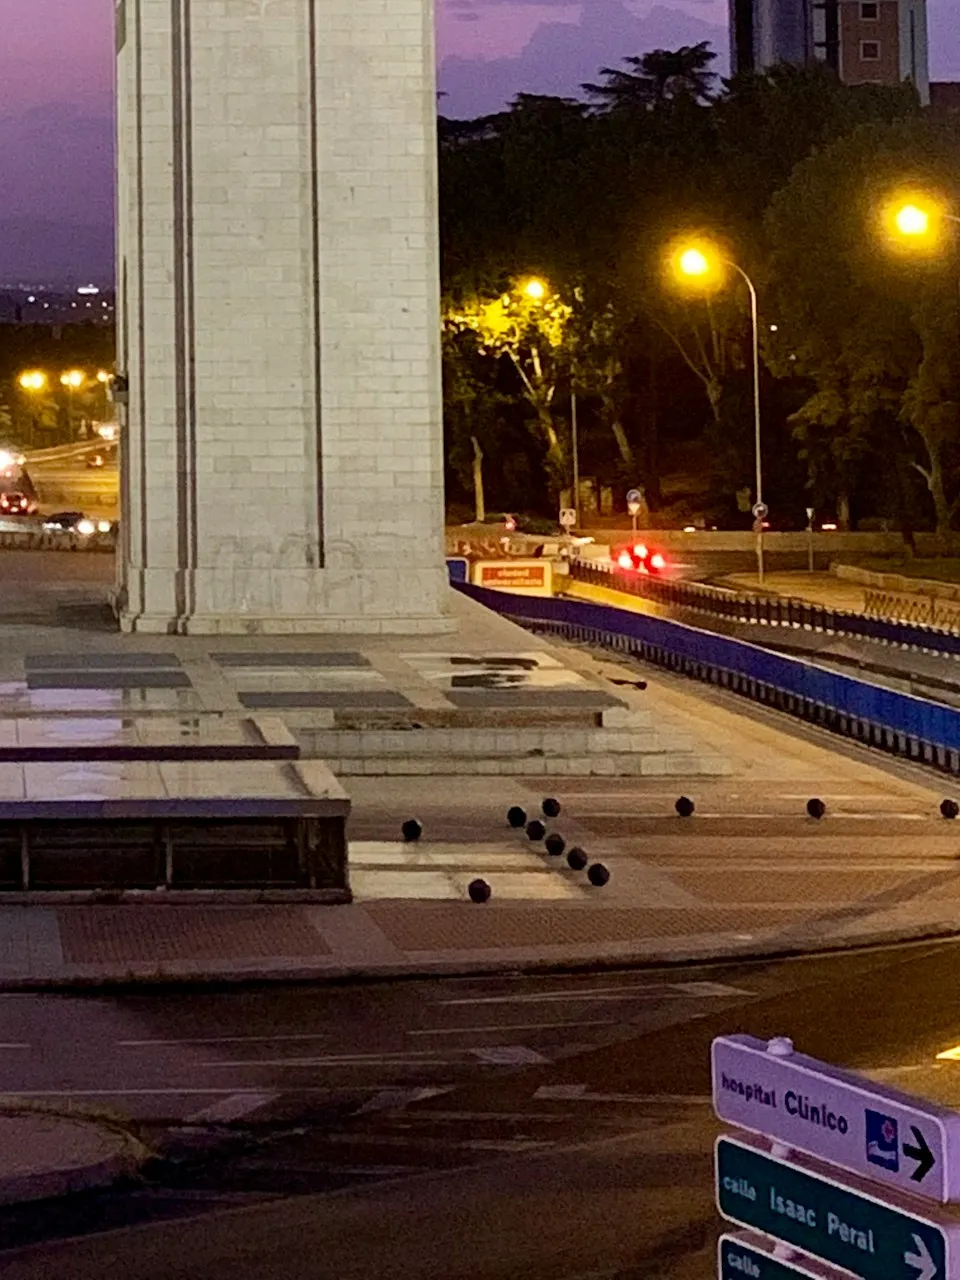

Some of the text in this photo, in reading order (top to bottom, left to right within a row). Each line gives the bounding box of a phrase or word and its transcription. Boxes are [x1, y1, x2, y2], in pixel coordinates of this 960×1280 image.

[722, 1071, 777, 1109] hospital
[723, 1176, 875, 1253] calle Isaac Peral
